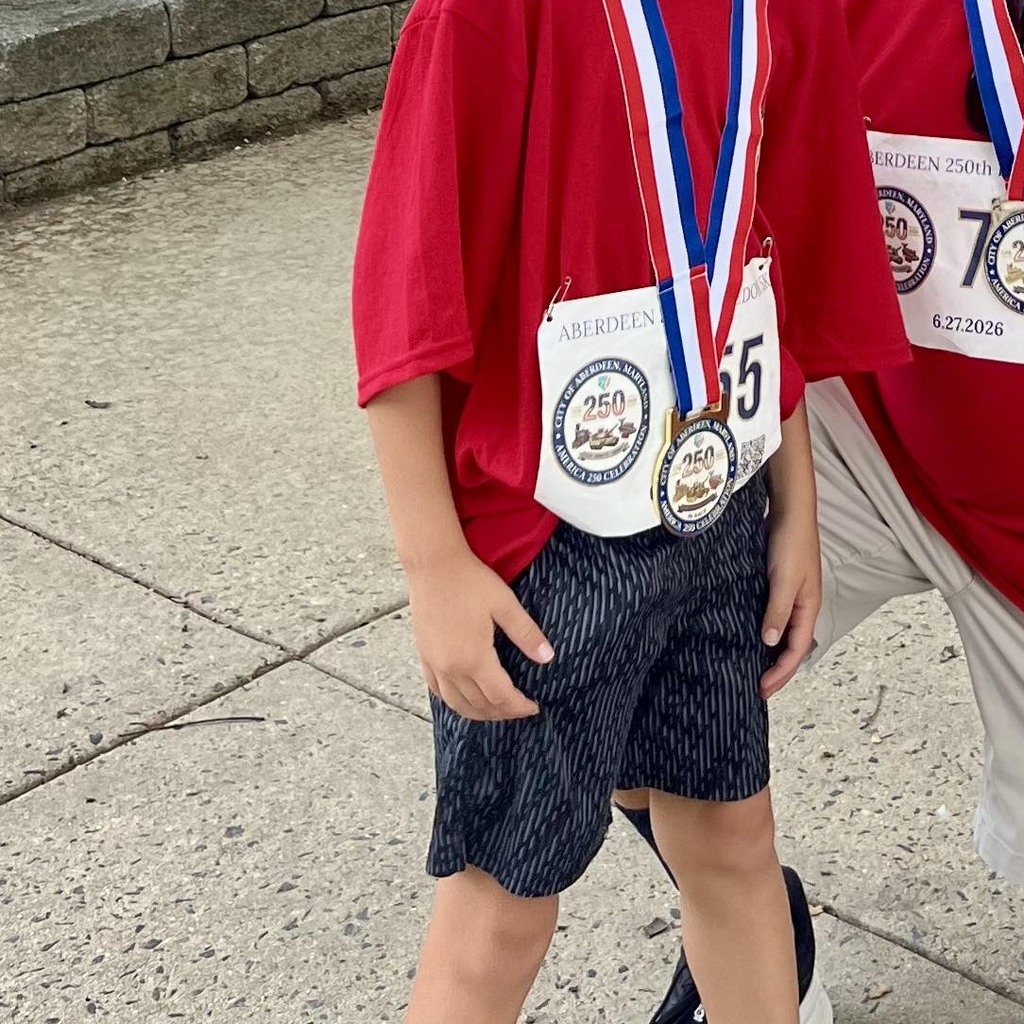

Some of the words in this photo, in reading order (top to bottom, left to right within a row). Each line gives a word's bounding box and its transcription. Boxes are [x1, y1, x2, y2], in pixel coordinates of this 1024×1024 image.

[945, 157, 992, 176] 250th
[882, 216, 908, 240] 50
[906, 197, 933, 245] MARYLAND
[988, 243, 997, 265] CITY
[993, 230, 1002, 243] OF
[991, 278, 1020, 310] AMERICA
[559, 309, 655, 342] ABERDEEN
[932, 313, 1004, 336] 6.27.2026
[555, 403, 566, 428] CITY
[564, 387, 575, 400] OF
[623, 363, 648, 409] MARYLAND
[583, 389, 625, 421] 250
[556, 444, 585, 481] AMERICA
[587, 473, 602, 483] 250
[603, 424, 648, 481] CELEBRATION
[660, 464, 670, 486] CITY
[667, 447, 676, 460] OF
[682, 445, 714, 478] 250
[661, 500, 682, 531] AMERICA
[696, 478, 734, 531] CELEBRATION
